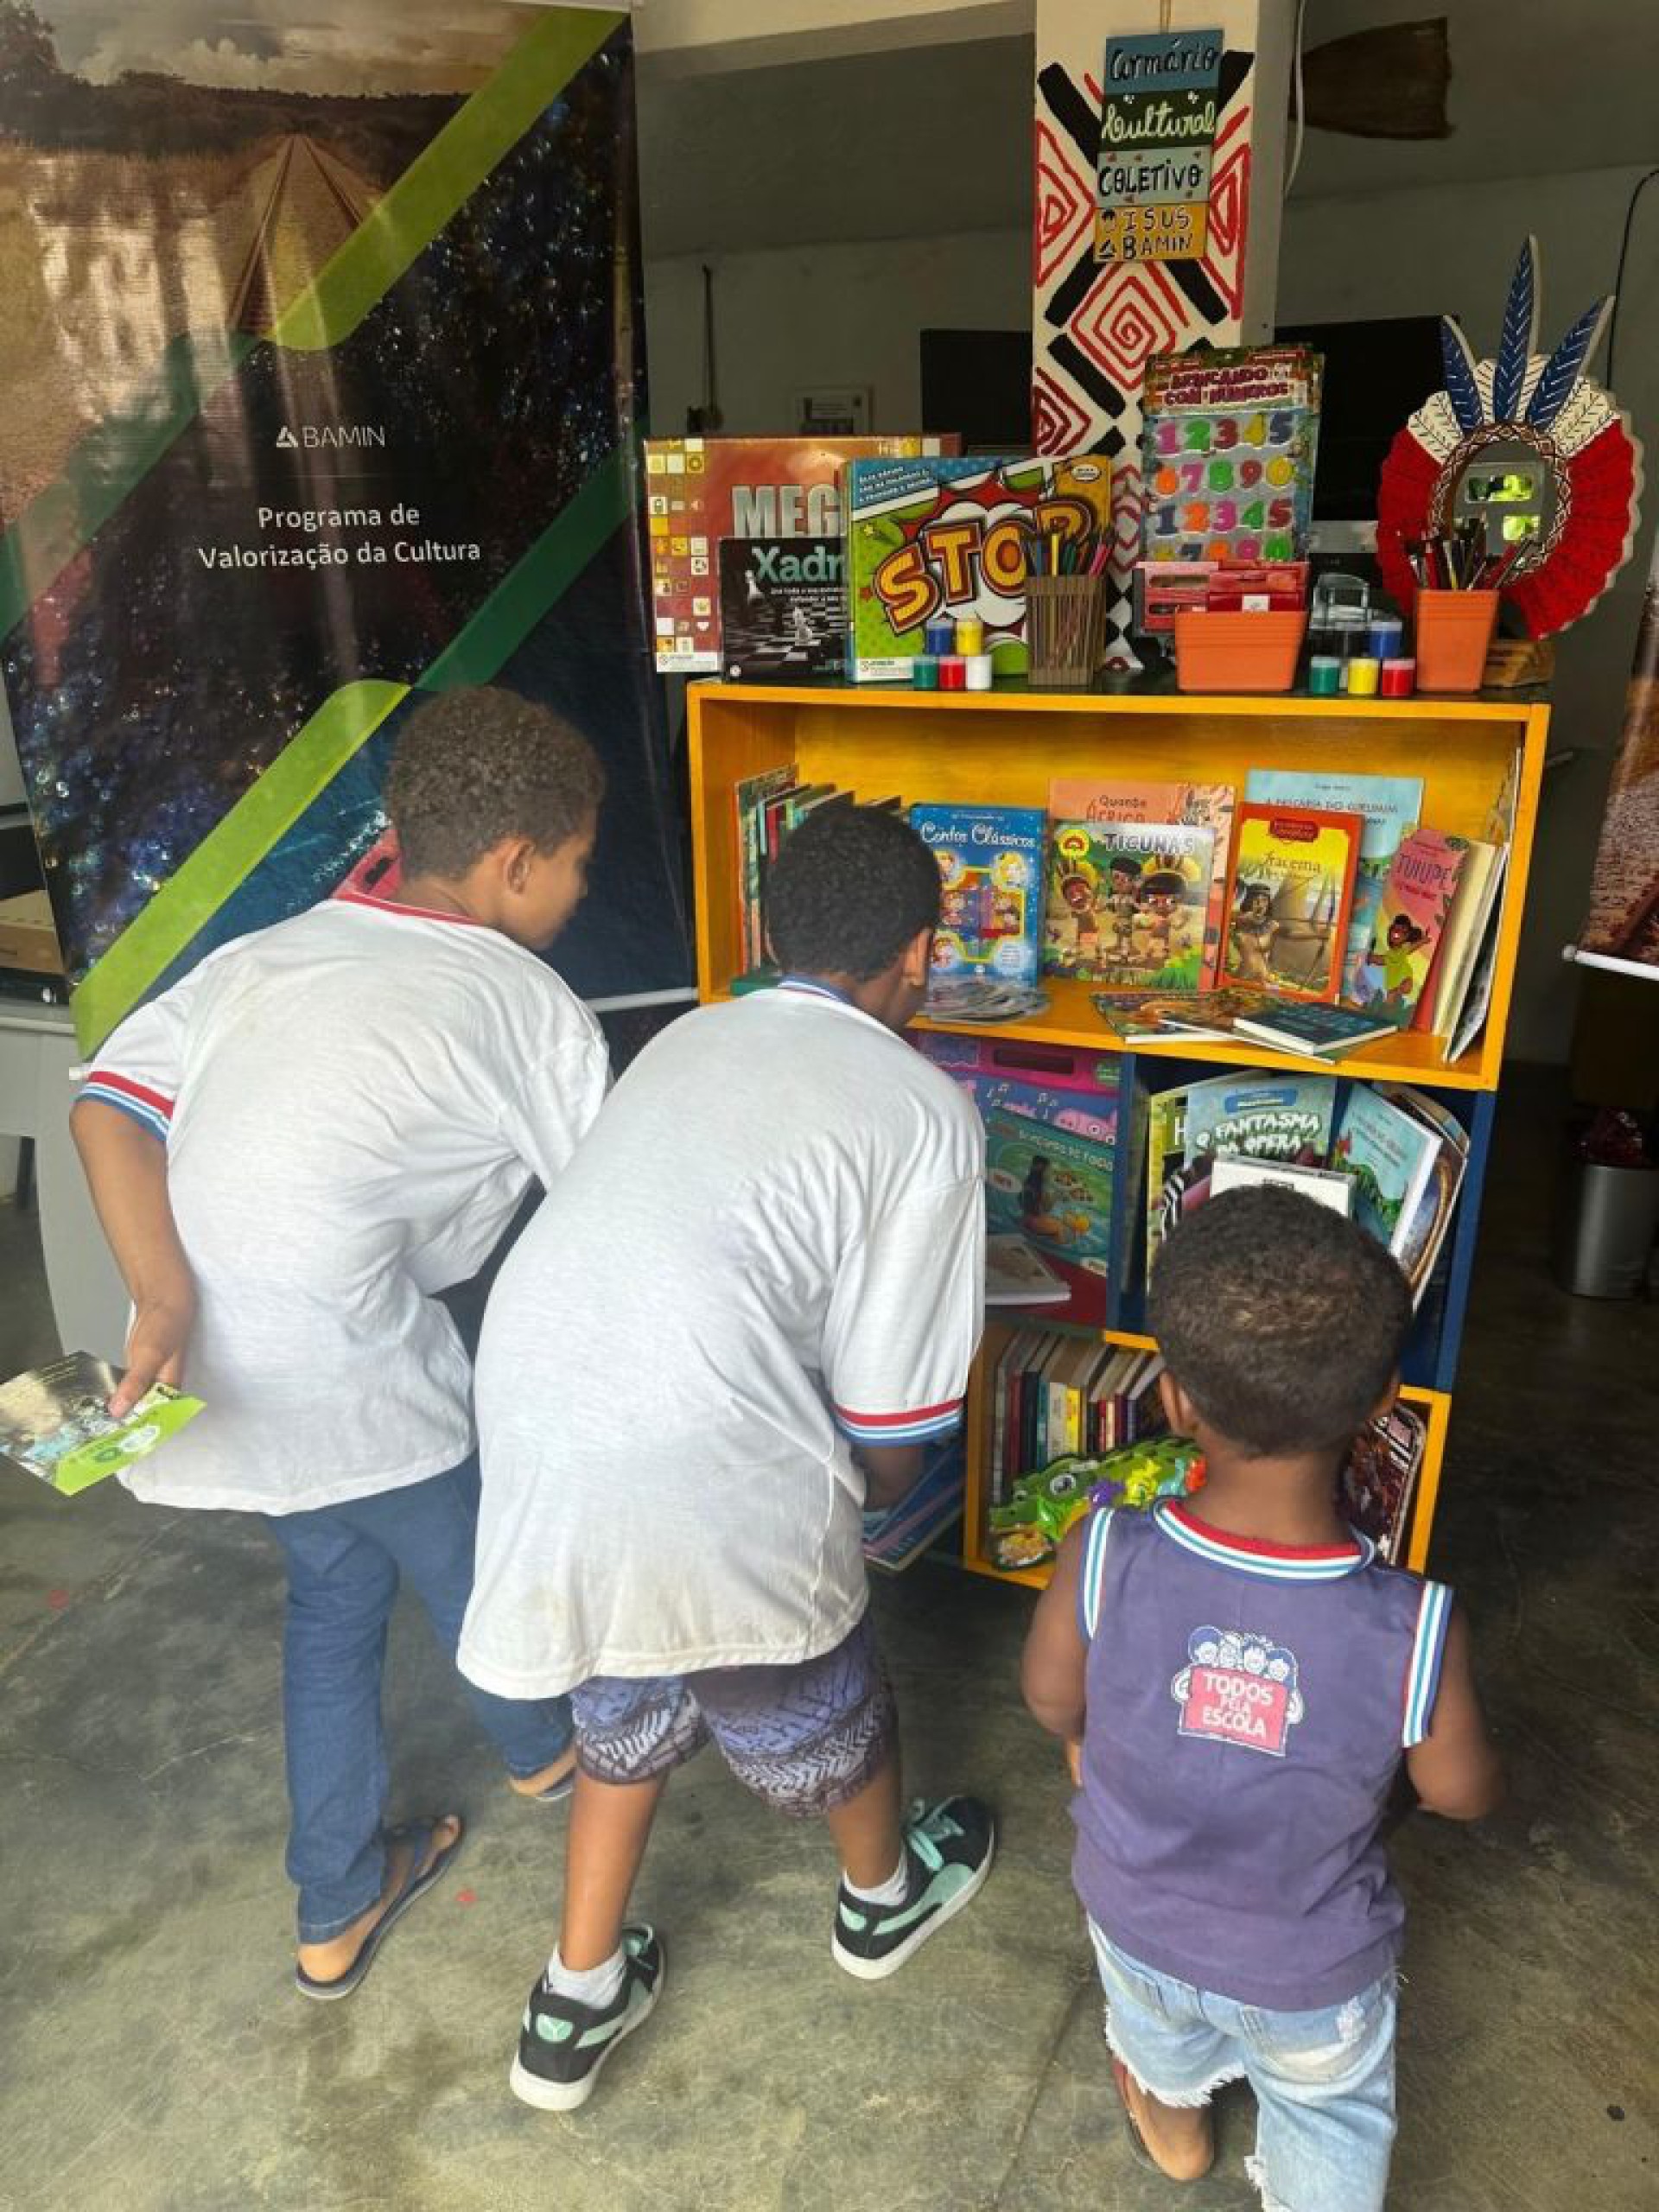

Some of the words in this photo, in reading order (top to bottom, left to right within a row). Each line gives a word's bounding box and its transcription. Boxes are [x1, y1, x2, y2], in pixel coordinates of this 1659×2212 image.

[1102, 99, 1215, 143] Cultural
[1100, 158, 1203, 196] COLETIVO
[1123, 233, 1193, 259] BAMIN
[302, 426, 385, 448] BAMIN
[258, 507, 382, 532] Programa
[390, 504, 421, 525] de
[732, 483, 844, 537] MEG
[198, 543, 349, 570] Valorização
[356, 541, 387, 563] da
[394, 539, 481, 563] Cultura
[752, 544, 843, 583] Xadr
[874, 496, 1093, 637] STOP
[919, 820, 969, 844] Contos
[1215, 1112, 1320, 1138] FANTASMA
[1203, 1674, 1273, 1707] TODOS
[1203, 1706, 1267, 1738] ESCOLA
